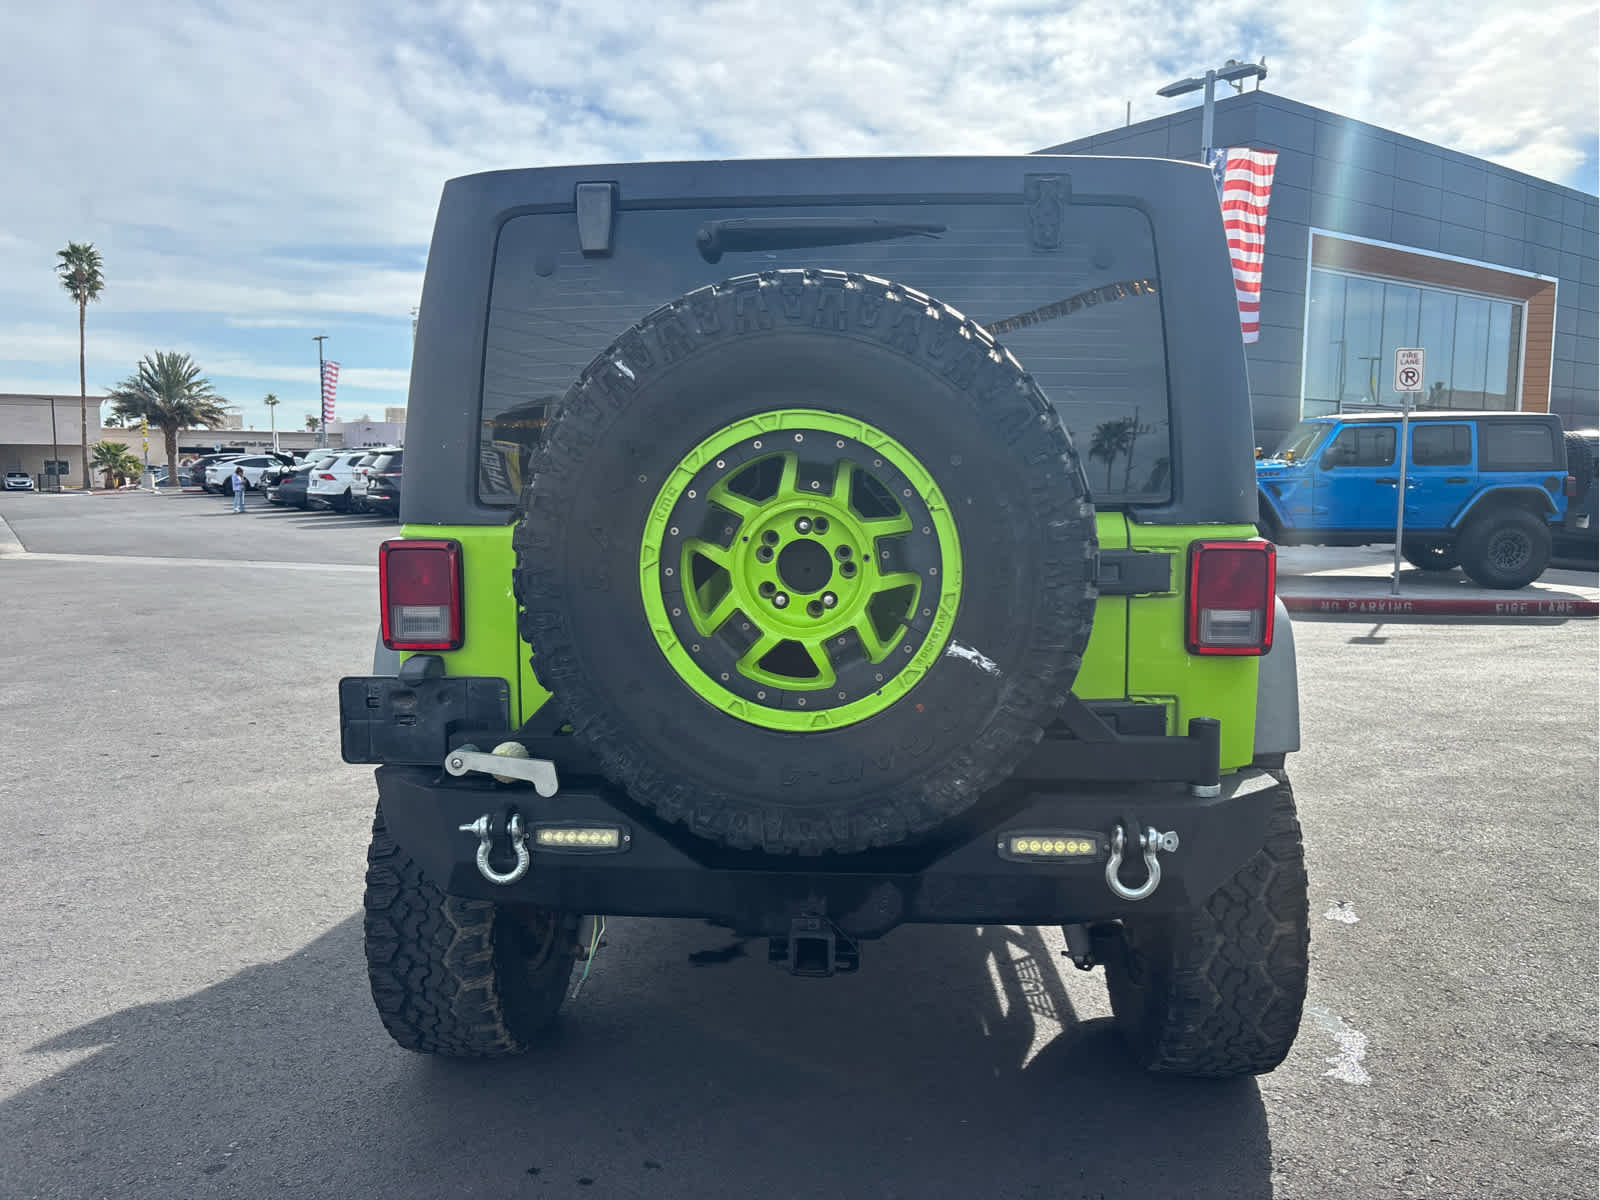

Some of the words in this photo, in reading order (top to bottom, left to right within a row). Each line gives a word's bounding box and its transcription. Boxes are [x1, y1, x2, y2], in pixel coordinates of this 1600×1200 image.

[1320, 600, 1340, 613] NO
[1347, 600, 1415, 614] PARKING
[1495, 602, 1529, 616] FIRE
[1537, 600, 1577, 616] LANE
